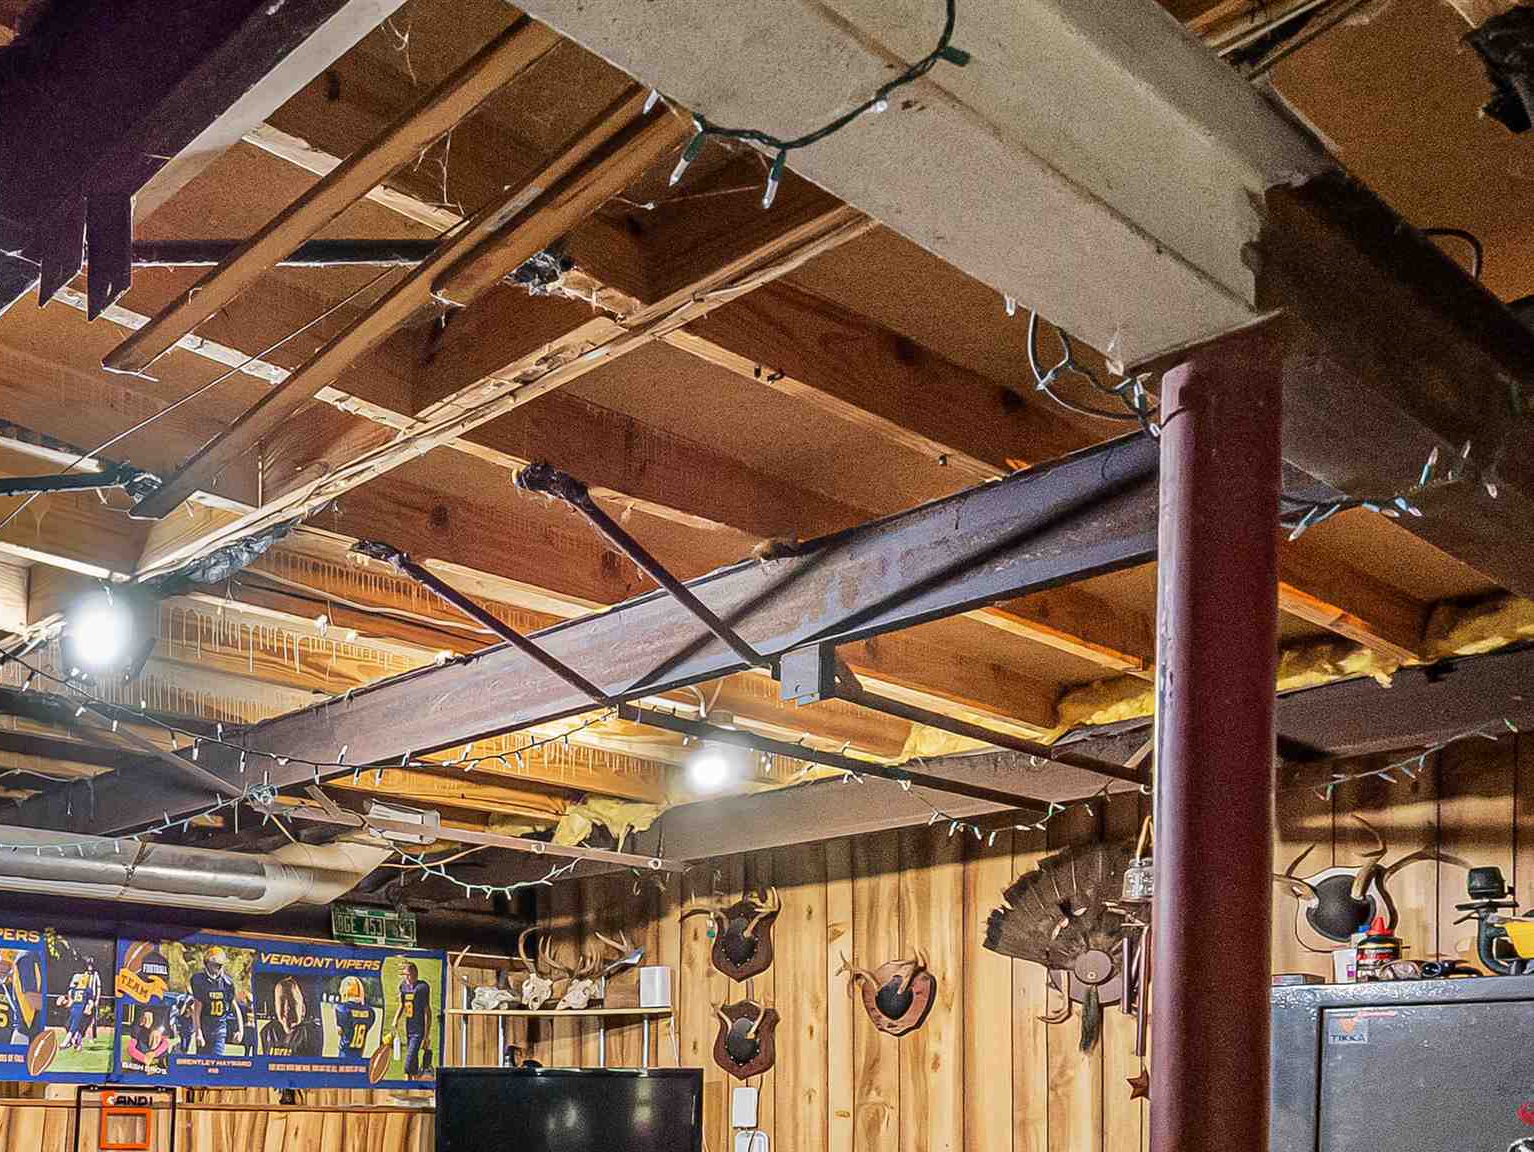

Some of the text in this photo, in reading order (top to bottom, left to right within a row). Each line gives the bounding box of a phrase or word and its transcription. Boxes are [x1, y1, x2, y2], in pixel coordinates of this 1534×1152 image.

[260, 952, 382, 971] VERMONT VIPERS
[120, 973, 149, 998] TEAM
[349, 1023, 366, 1049] 18
[1330, 1034, 1366, 1043] TIKKA
